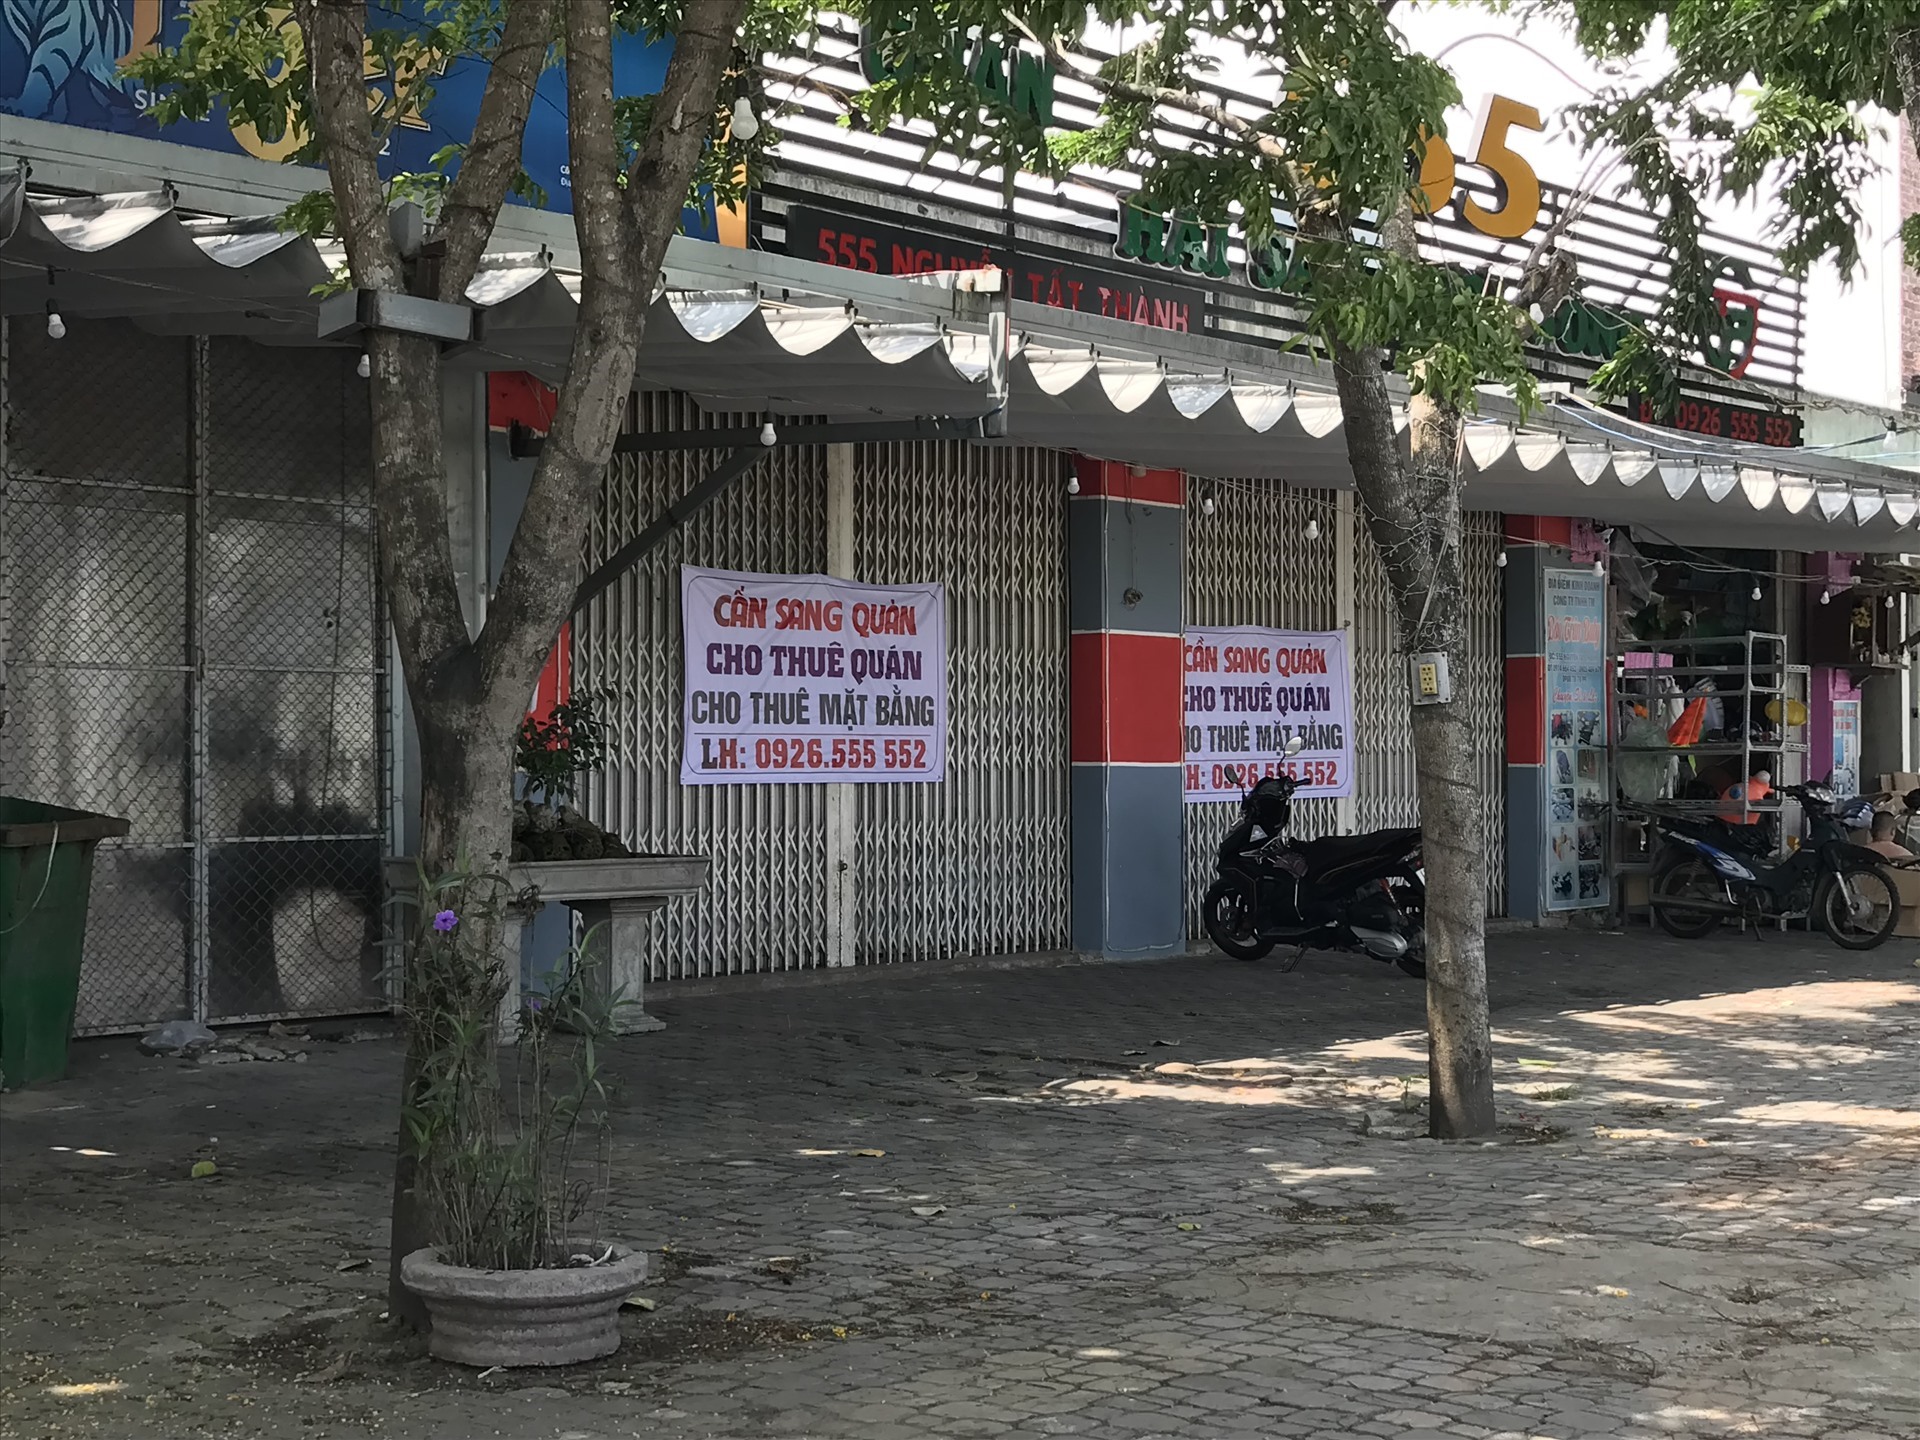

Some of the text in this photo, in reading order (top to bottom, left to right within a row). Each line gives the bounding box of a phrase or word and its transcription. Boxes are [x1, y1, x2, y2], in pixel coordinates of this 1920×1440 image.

[818, 228, 879, 274] 555
[1098, 286, 1190, 333] THÀNH
[1730, 410, 1759, 442] 555
[1764, 416, 1793, 446] 552
[774, 597, 843, 633] SANG
[706, 641, 922, 685] CHO THUÊ QUÁN
[1223, 646, 1270, 674] SANG
[691, 685, 935, 731] CHO THUÊ MẶT BẰNG
[1220, 682, 1272, 712] THUÊ
[1276, 683, 1331, 717] QUÁN
[701, 738, 926, 769] LH: 0926.555 552
[1207, 720, 1250, 753] THUÊ
[1256, 720, 1293, 757] MẶT
[1297, 715, 1343, 751] BẰNG
[1304, 761, 1338, 786] 552
